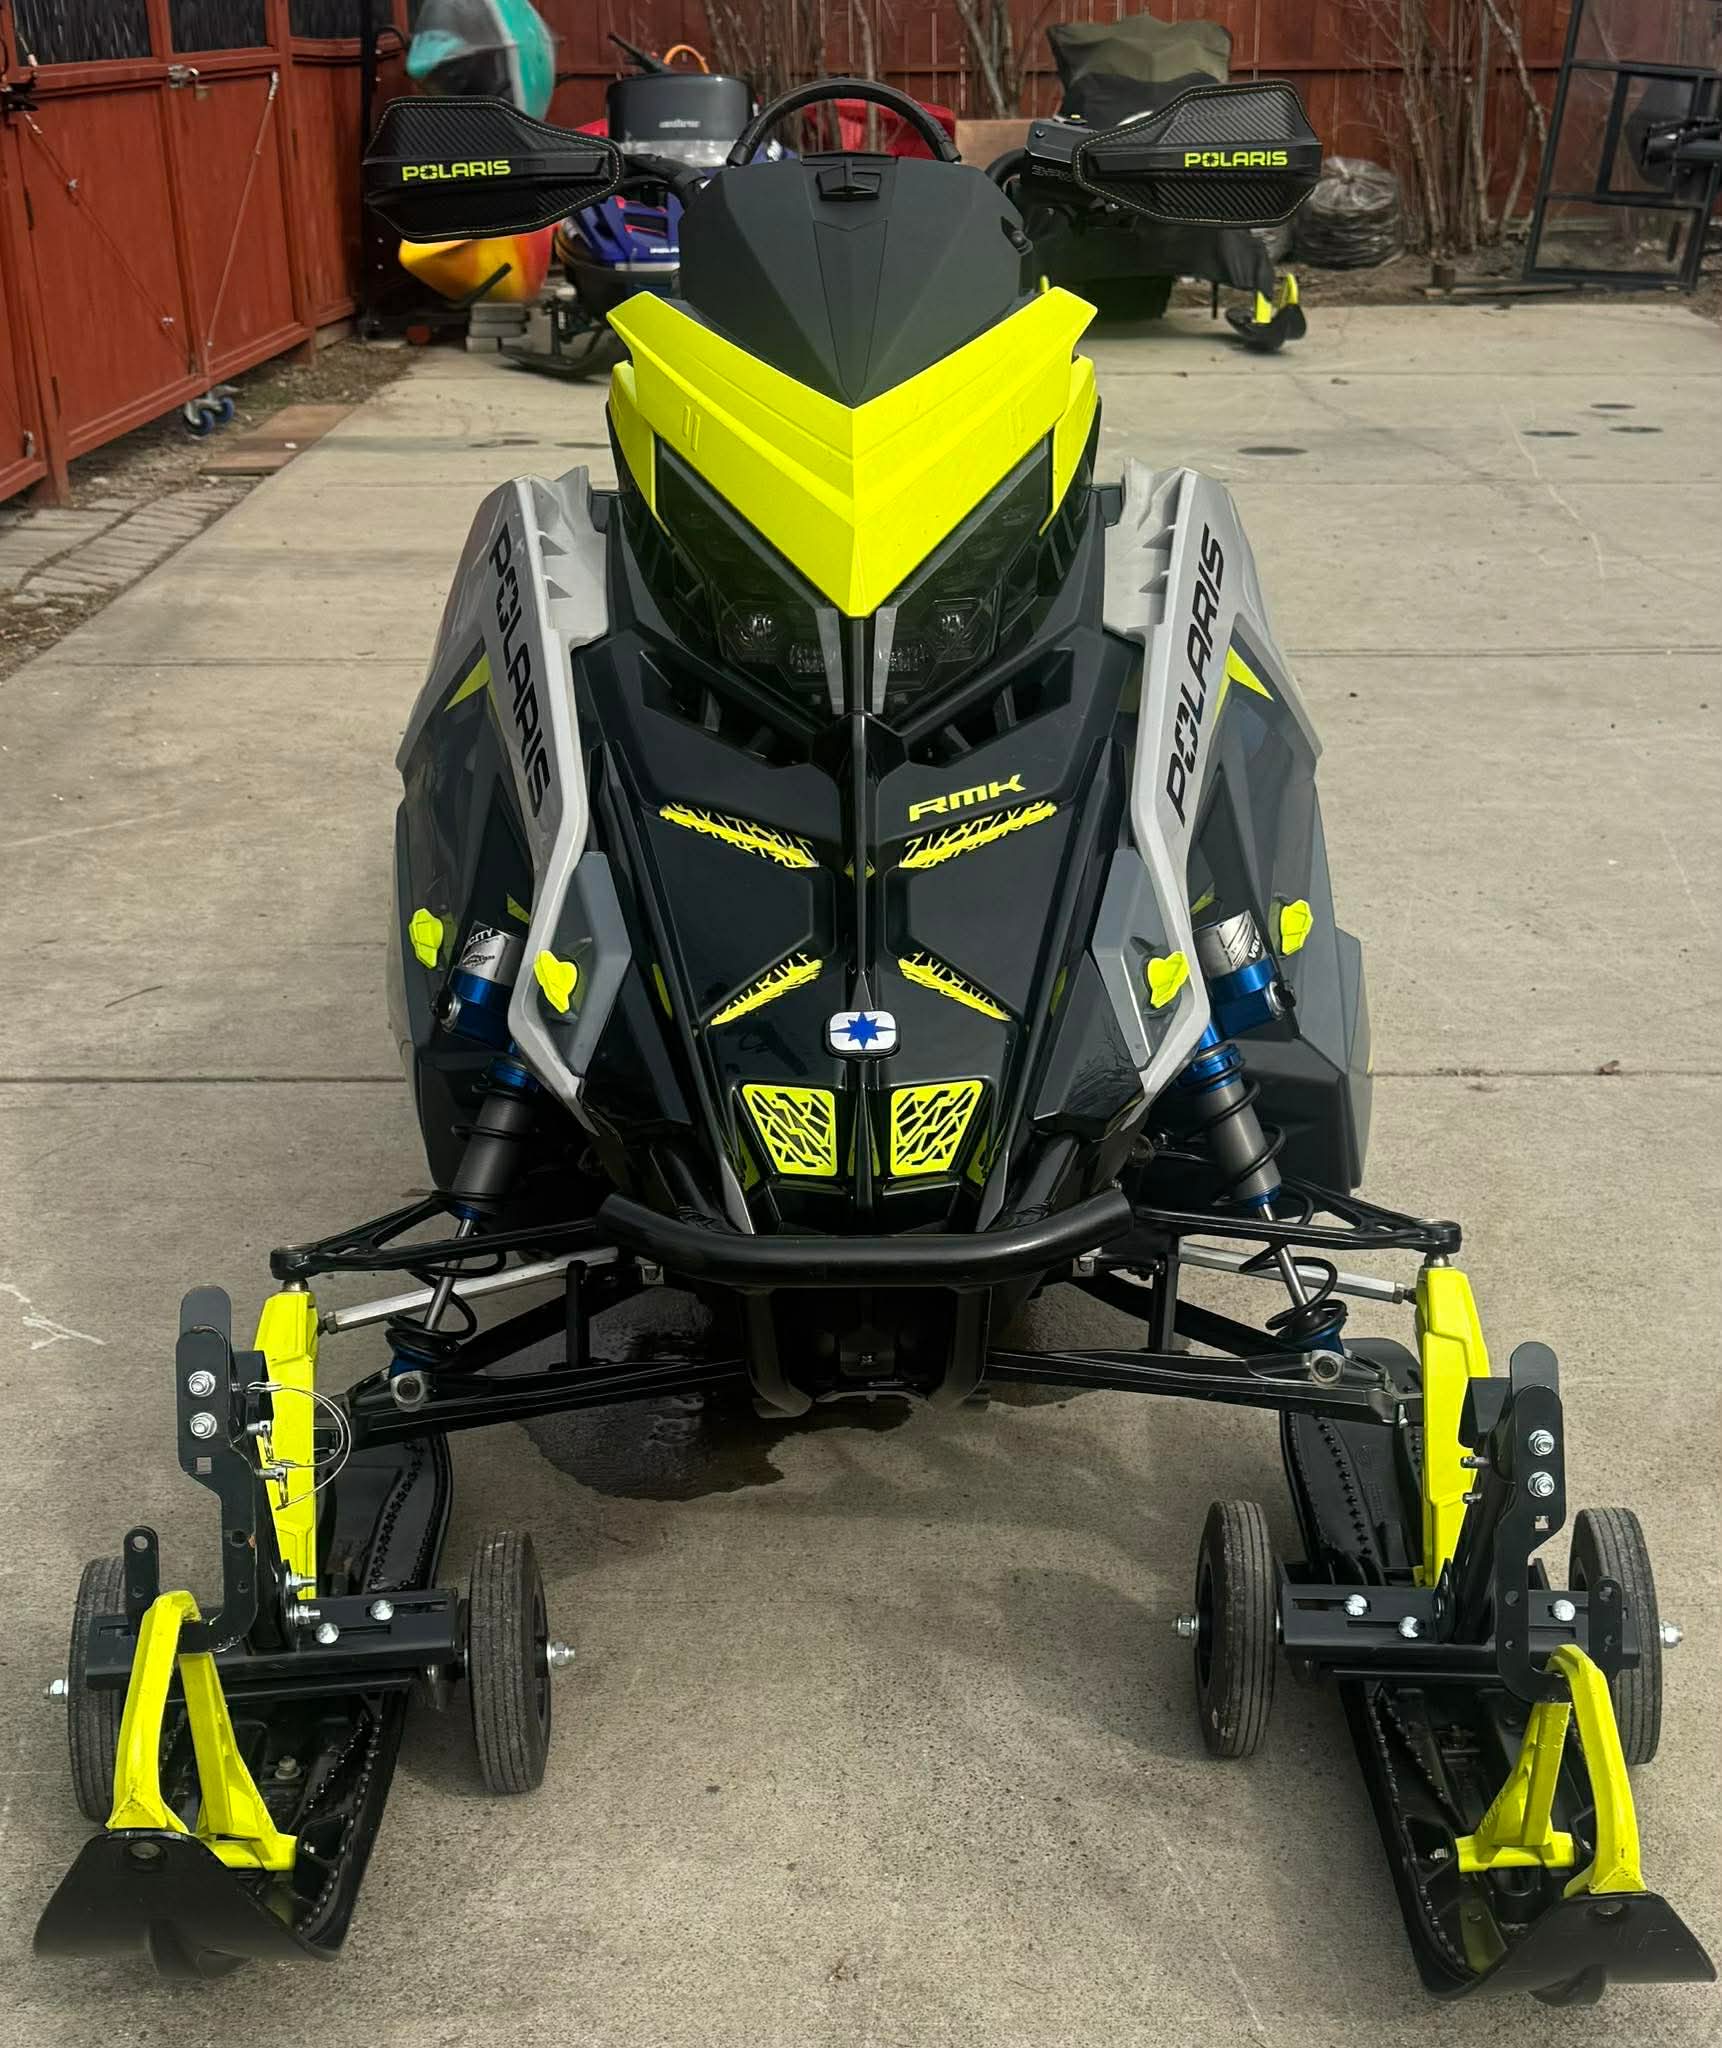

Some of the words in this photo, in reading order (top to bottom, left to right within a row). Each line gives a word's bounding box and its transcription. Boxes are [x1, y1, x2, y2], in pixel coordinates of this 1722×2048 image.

[402, 160, 511, 181] POLARIS
[1184, 151, 1288, 168] POLARIS
[489, 522, 550, 818] POLARIS
[1166, 522, 1224, 828] POLARIS
[909, 774, 1026, 822] RMK
